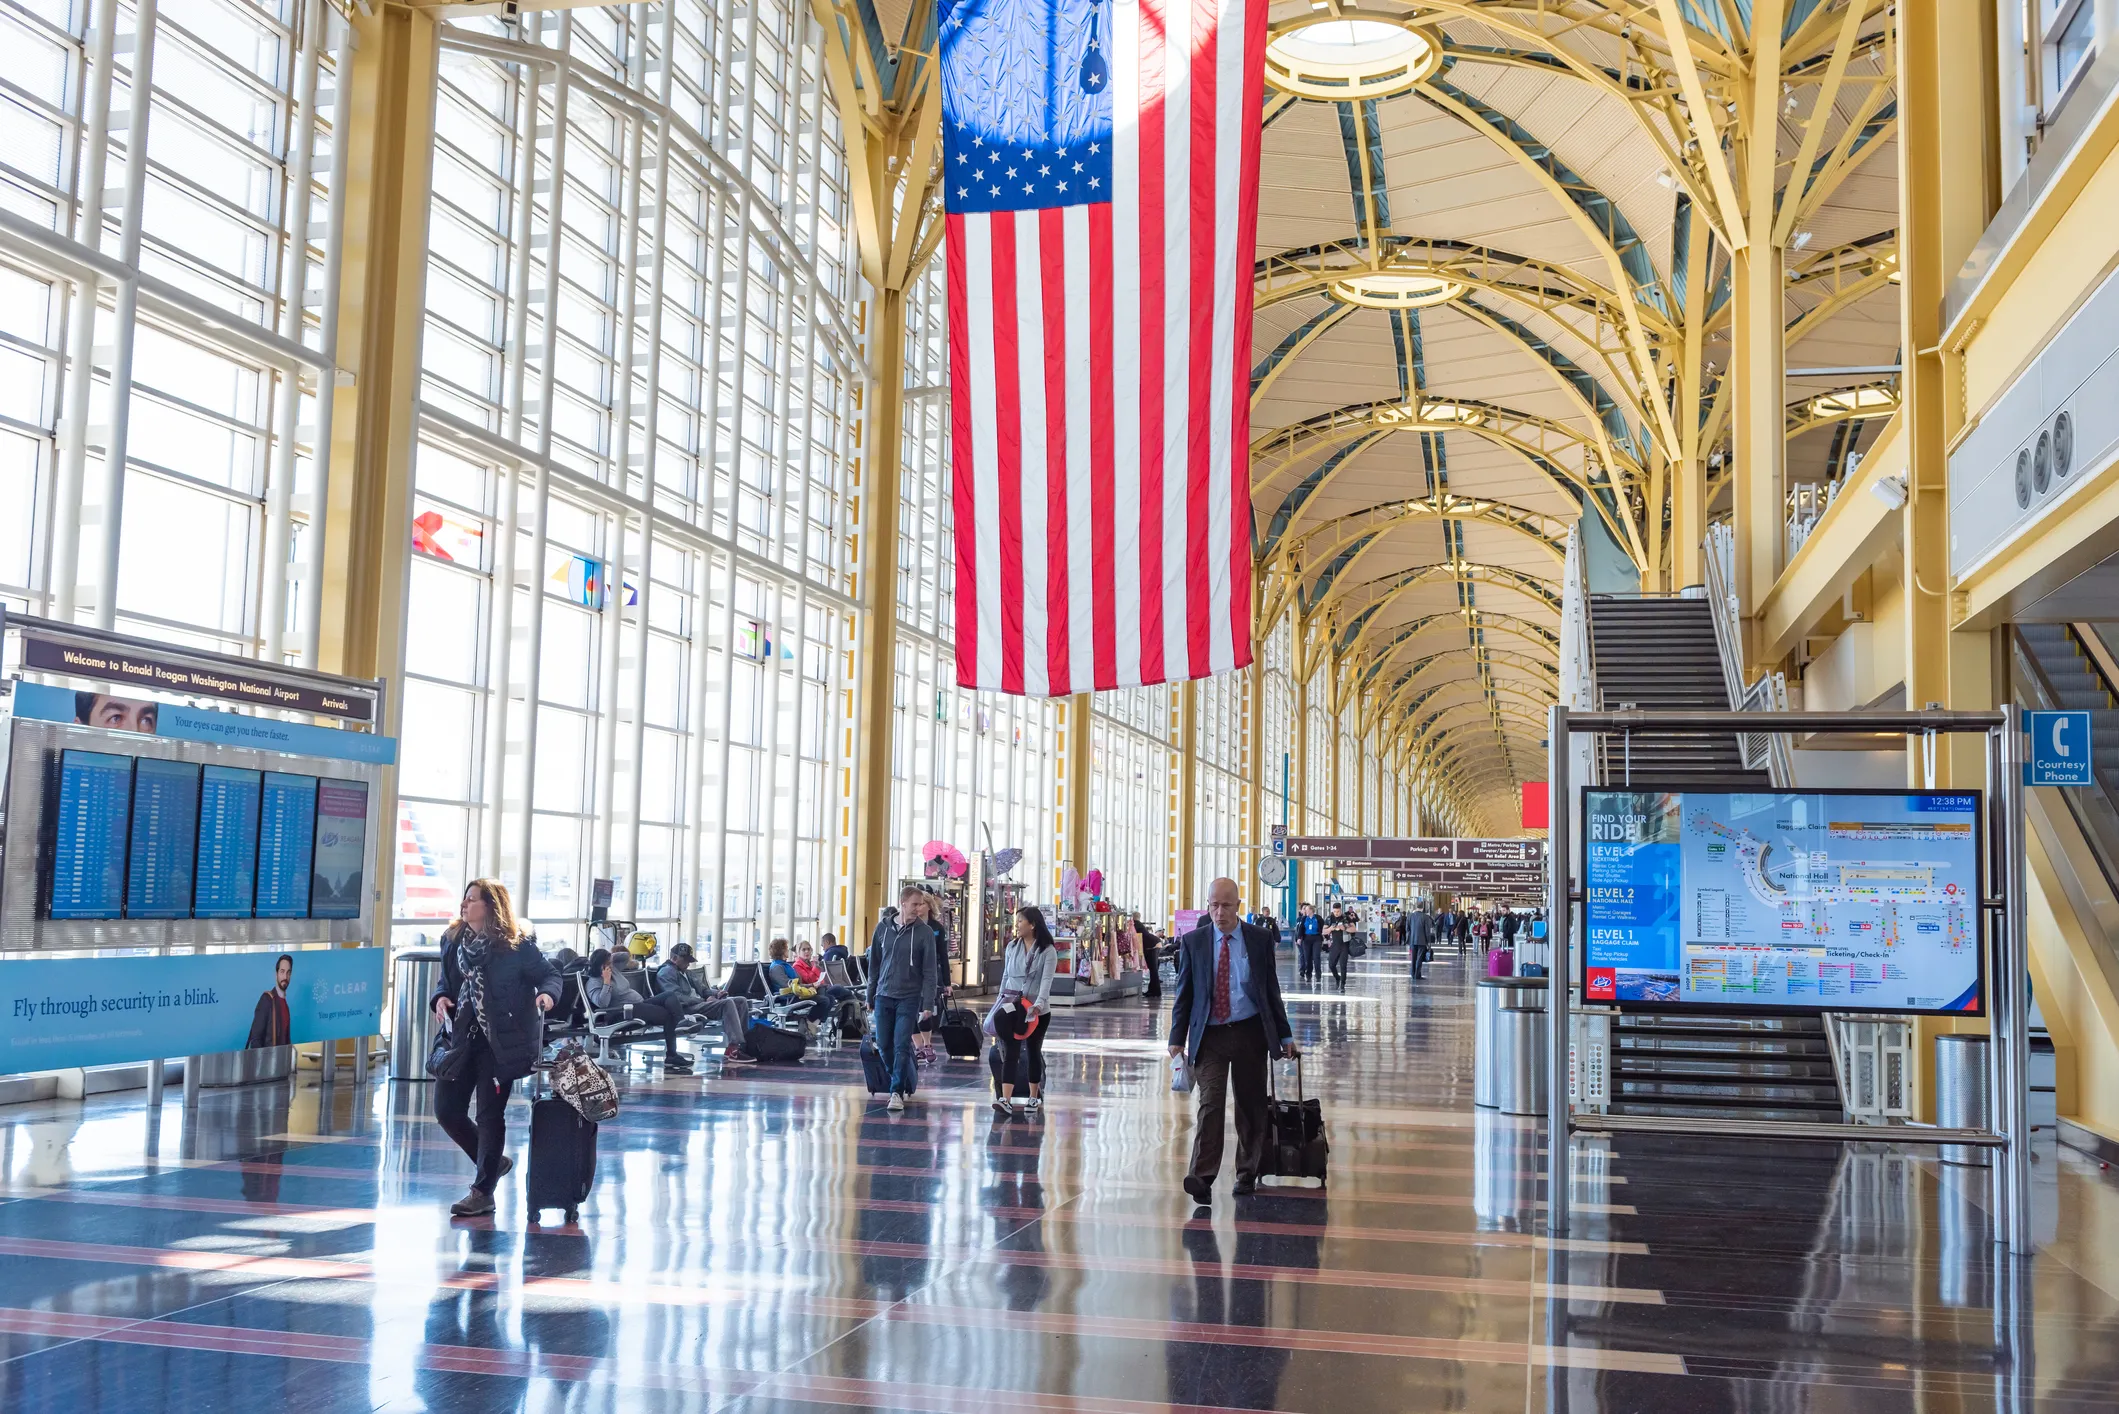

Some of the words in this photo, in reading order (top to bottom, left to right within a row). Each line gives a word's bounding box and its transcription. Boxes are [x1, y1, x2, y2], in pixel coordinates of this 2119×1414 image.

[64, 651, 106, 668] Welcome
[110, 660, 119, 670] to
[122, 661, 152, 676] Ronald
[156, 668, 188, 684] Reagan
[191, 674, 237, 692] Washington
[240, 682, 271, 696] National
[274, 688, 300, 702] Airport
[322, 697, 348, 711] Arrivals
[174, 716, 192, 728] Your
[193, 720, 210, 731] eyes
[211, 723, 224, 732] can
[225, 725, 236, 736] get
[237, 728, 250, 737] you
[251, 726, 269, 738] there
[270, 729, 290, 741] faster.
[2036, 760, 2086, 771] Courtesy
[2044, 771, 2078, 781] Phone
[1592, 814, 1615, 823] FIND
[1618, 814, 1647, 823] YOUR
[1592, 824, 1636, 840] RIDE
[1592, 846, 1624, 856] LEVEL
[1592, 888, 1624, 898] LEVEL
[1627, 888, 1634, 898] 2
[1592, 929, 1624, 939] LEVEL
[1628, 930, 1632, 940] 1
[333, 981, 367, 994] CLEAR
[14, 998, 37, 1021] Fly
[40, 995, 98, 1018] through
[101, 991, 155, 1013] security
[158, 990, 170, 1007] in
[174, 994, 181, 1006] a
[184, 987, 219, 1006] blink.
